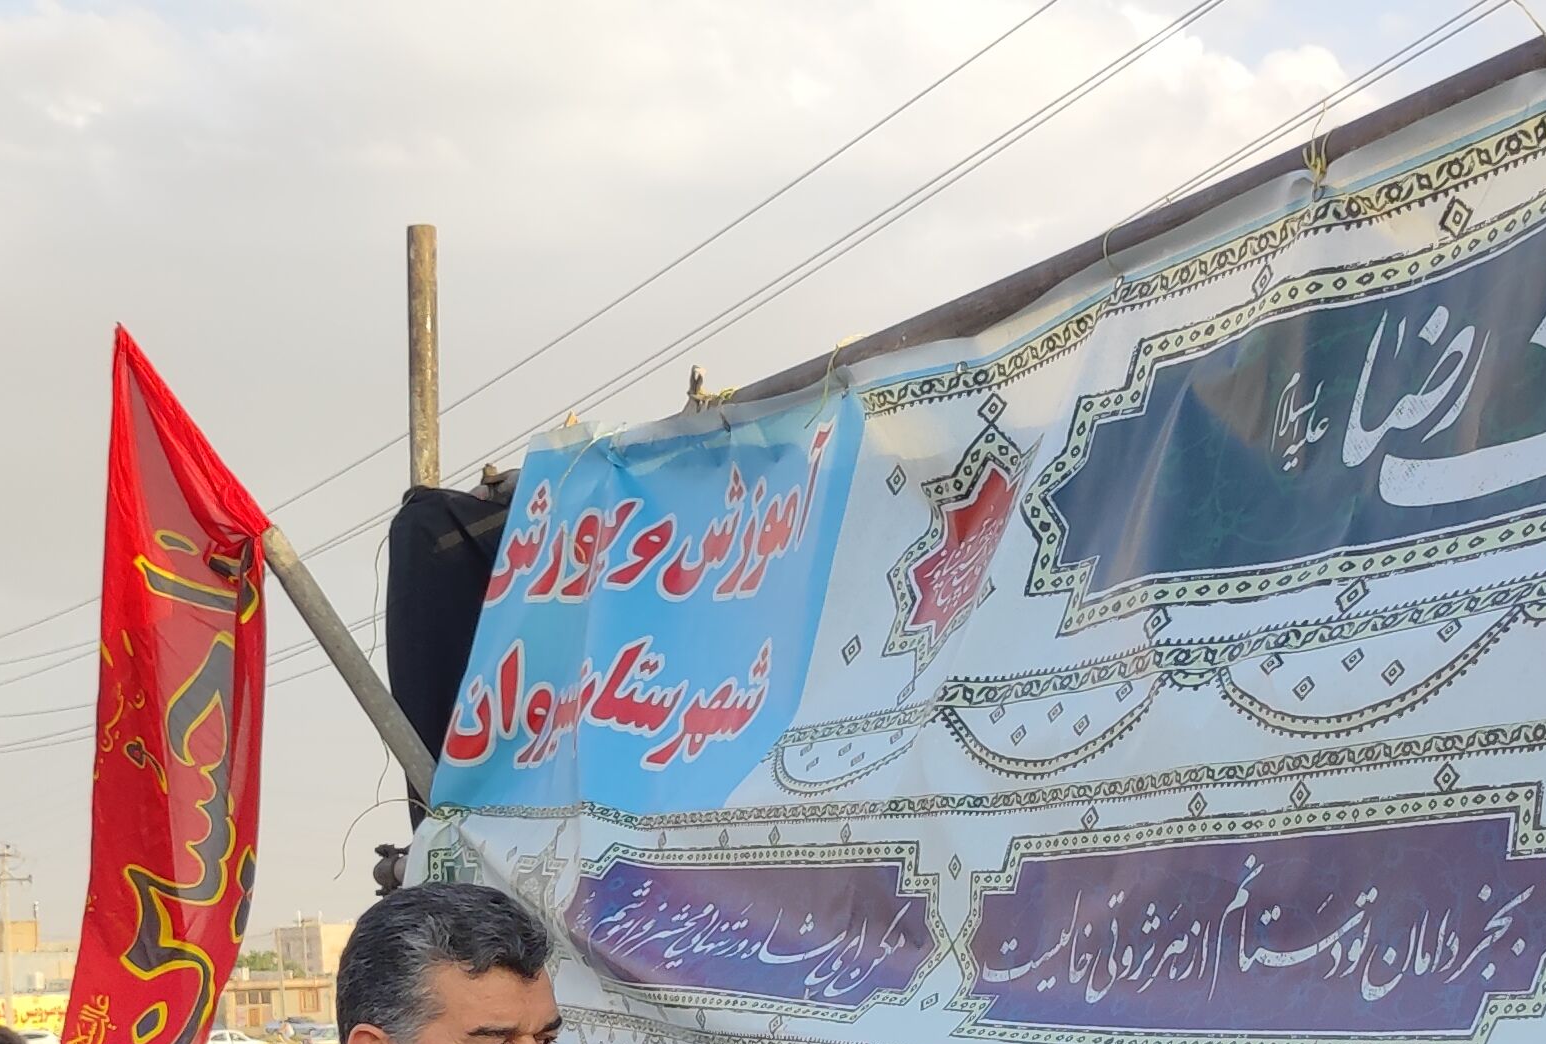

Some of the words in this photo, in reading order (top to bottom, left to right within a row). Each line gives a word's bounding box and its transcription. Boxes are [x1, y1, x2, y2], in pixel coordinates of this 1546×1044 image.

[1342, 305, 1491, 468] رضا
[602, 513, 675, 592] و
[657, 420, 835, 602] آموزش
[981, 889, 1093, 993] خالیست
[1085, 889, 1161, 1004] ثروتی
[1137, 903, 1189, 993] هر
[1177, 919, 1211, 981] از
[1339, 886, 1379, 978] تو
[1361, 908, 1459, 1002] دامان
